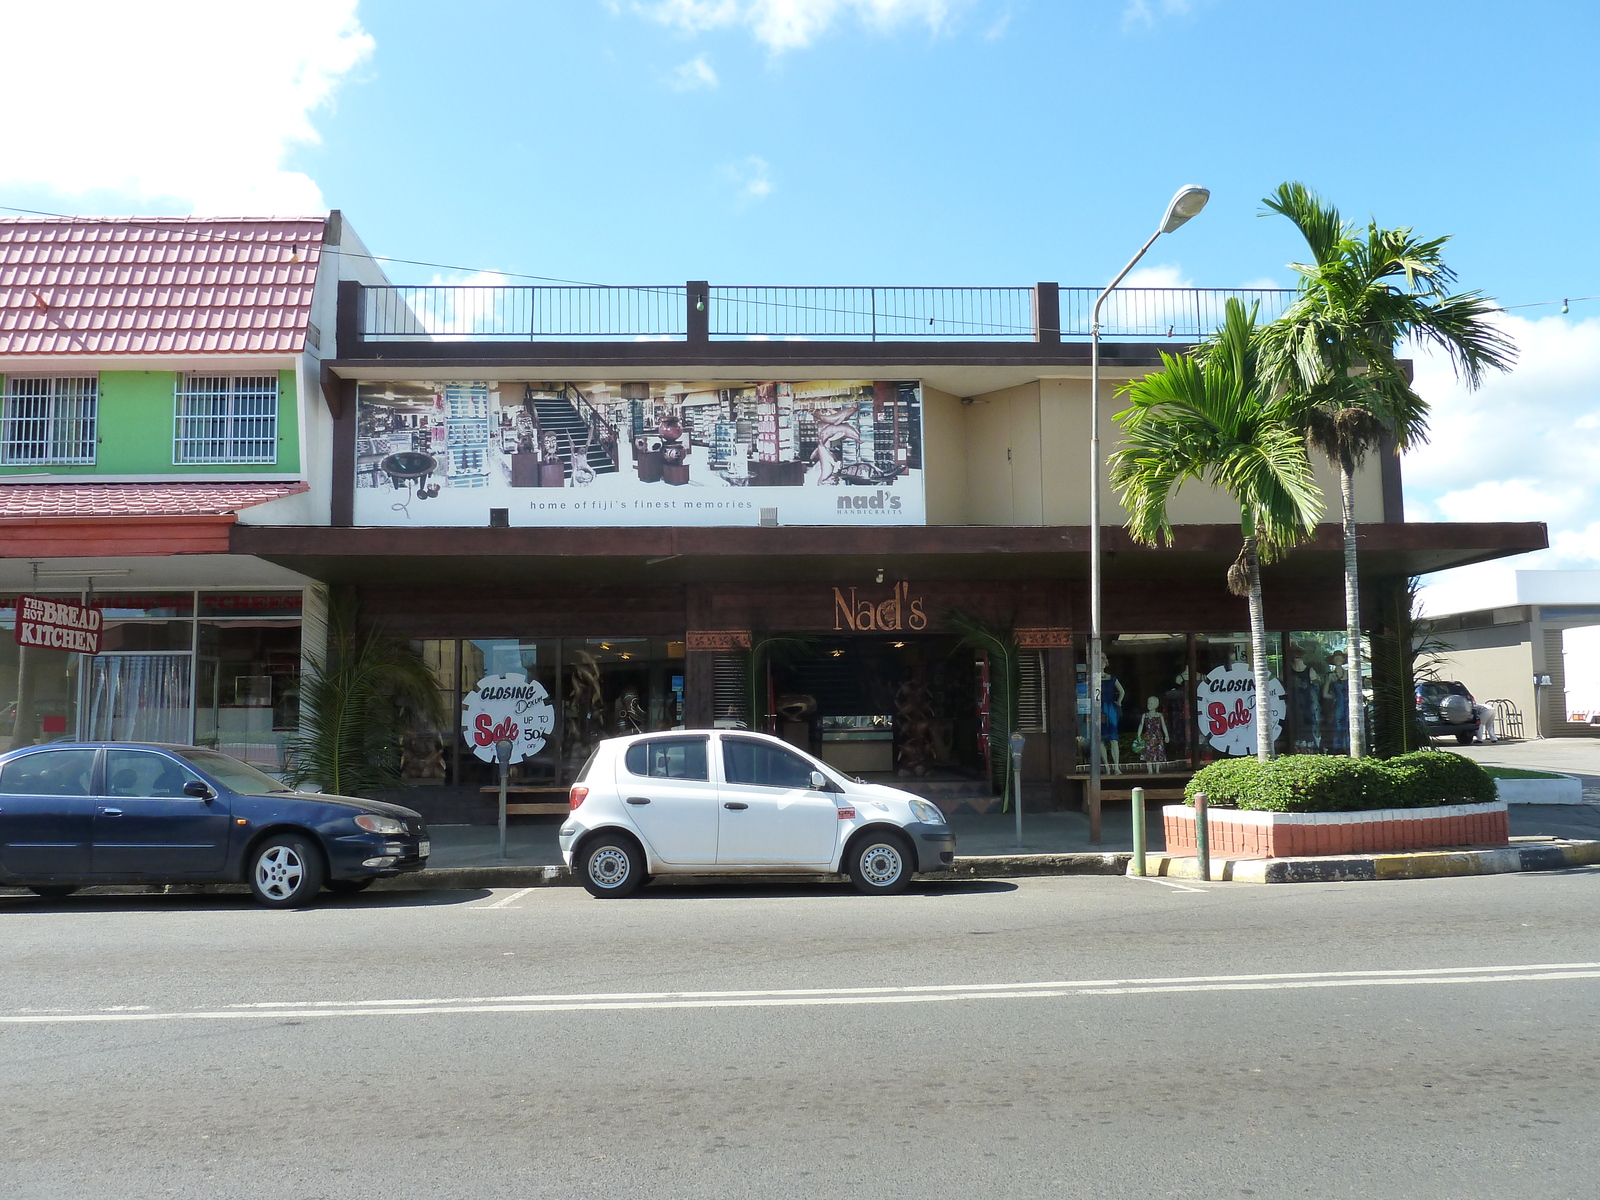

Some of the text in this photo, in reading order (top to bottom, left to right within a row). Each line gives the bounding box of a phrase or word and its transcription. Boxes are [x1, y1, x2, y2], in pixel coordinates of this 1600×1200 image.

[530, 500, 752, 510] home of fiji's finest memories
[837, 490, 902, 509] nad's
[24, 597, 44, 610] THE
[832, 581, 927, 631] Nad's
[23, 608, 43, 621] HOT
[43, 601, 100, 630] BREAD
[21, 622, 98, 652] KITCHEN
[480, 686, 536, 700] CLOSING
[1209, 679, 1257, 693] CLOSIN
[523, 715, 548, 724] UP TO
[1208, 698, 1252, 735] Sale
[474, 714, 519, 746] Sale
